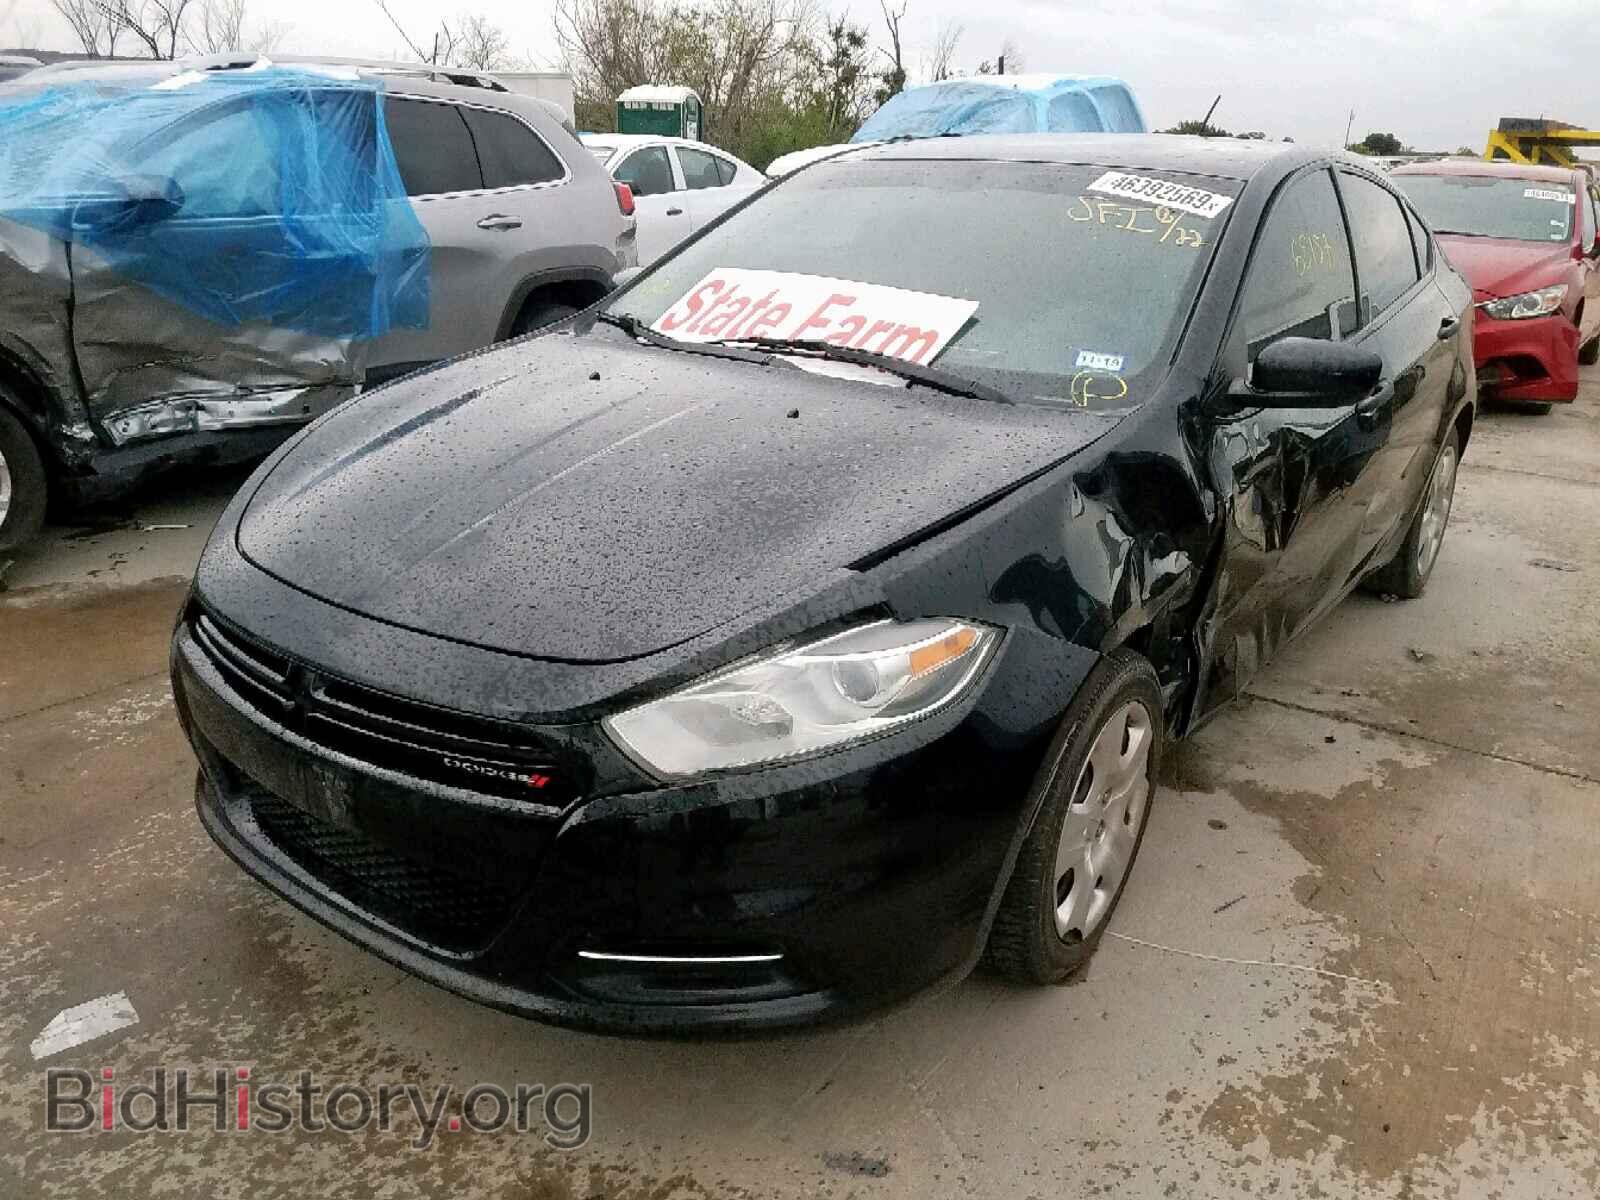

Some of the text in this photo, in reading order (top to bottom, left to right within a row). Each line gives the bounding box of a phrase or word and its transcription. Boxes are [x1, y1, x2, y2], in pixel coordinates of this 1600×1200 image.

[660, 279, 939, 366] State Farm
[443, 757, 531, 783] DODGE
